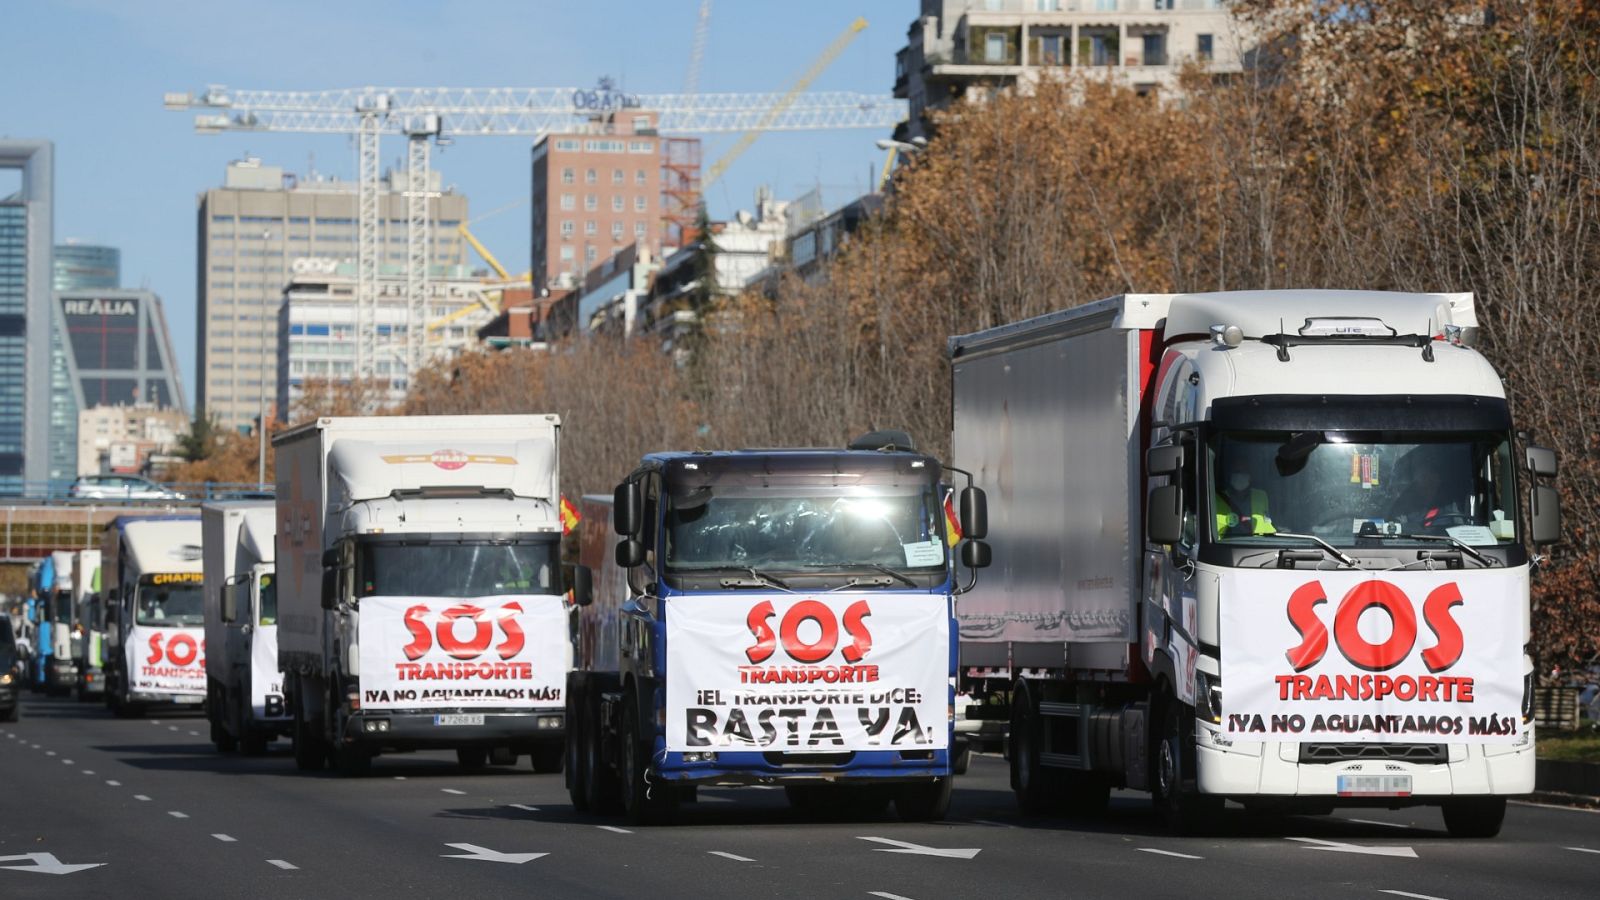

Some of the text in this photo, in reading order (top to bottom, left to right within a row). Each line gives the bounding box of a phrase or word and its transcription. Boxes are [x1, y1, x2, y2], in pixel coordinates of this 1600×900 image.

[65, 299, 136, 315] REALIA
[402, 601, 525, 660] SOS
[745, 599, 872, 664] SOS
[1285, 579, 1464, 673] SOS
[395, 662, 533, 680] TRANSPORTE
[737, 664, 879, 684] TRANSPORTE
[394, 689, 417, 701] NO
[420, 688, 524, 701] AGUANTAMOS
[528, 686, 561, 701] MÁS!
[733, 689, 865, 705] TRANSPORTE
[870, 687, 922, 704] DICE:
[1275, 674, 1474, 702] TRANSPORTE
[686, 707, 844, 747] BASTA
[1271, 714, 1306, 734] NO
[1310, 714, 1463, 735] AGUANTAMOS
[1468, 712, 1517, 736] MÁS!
